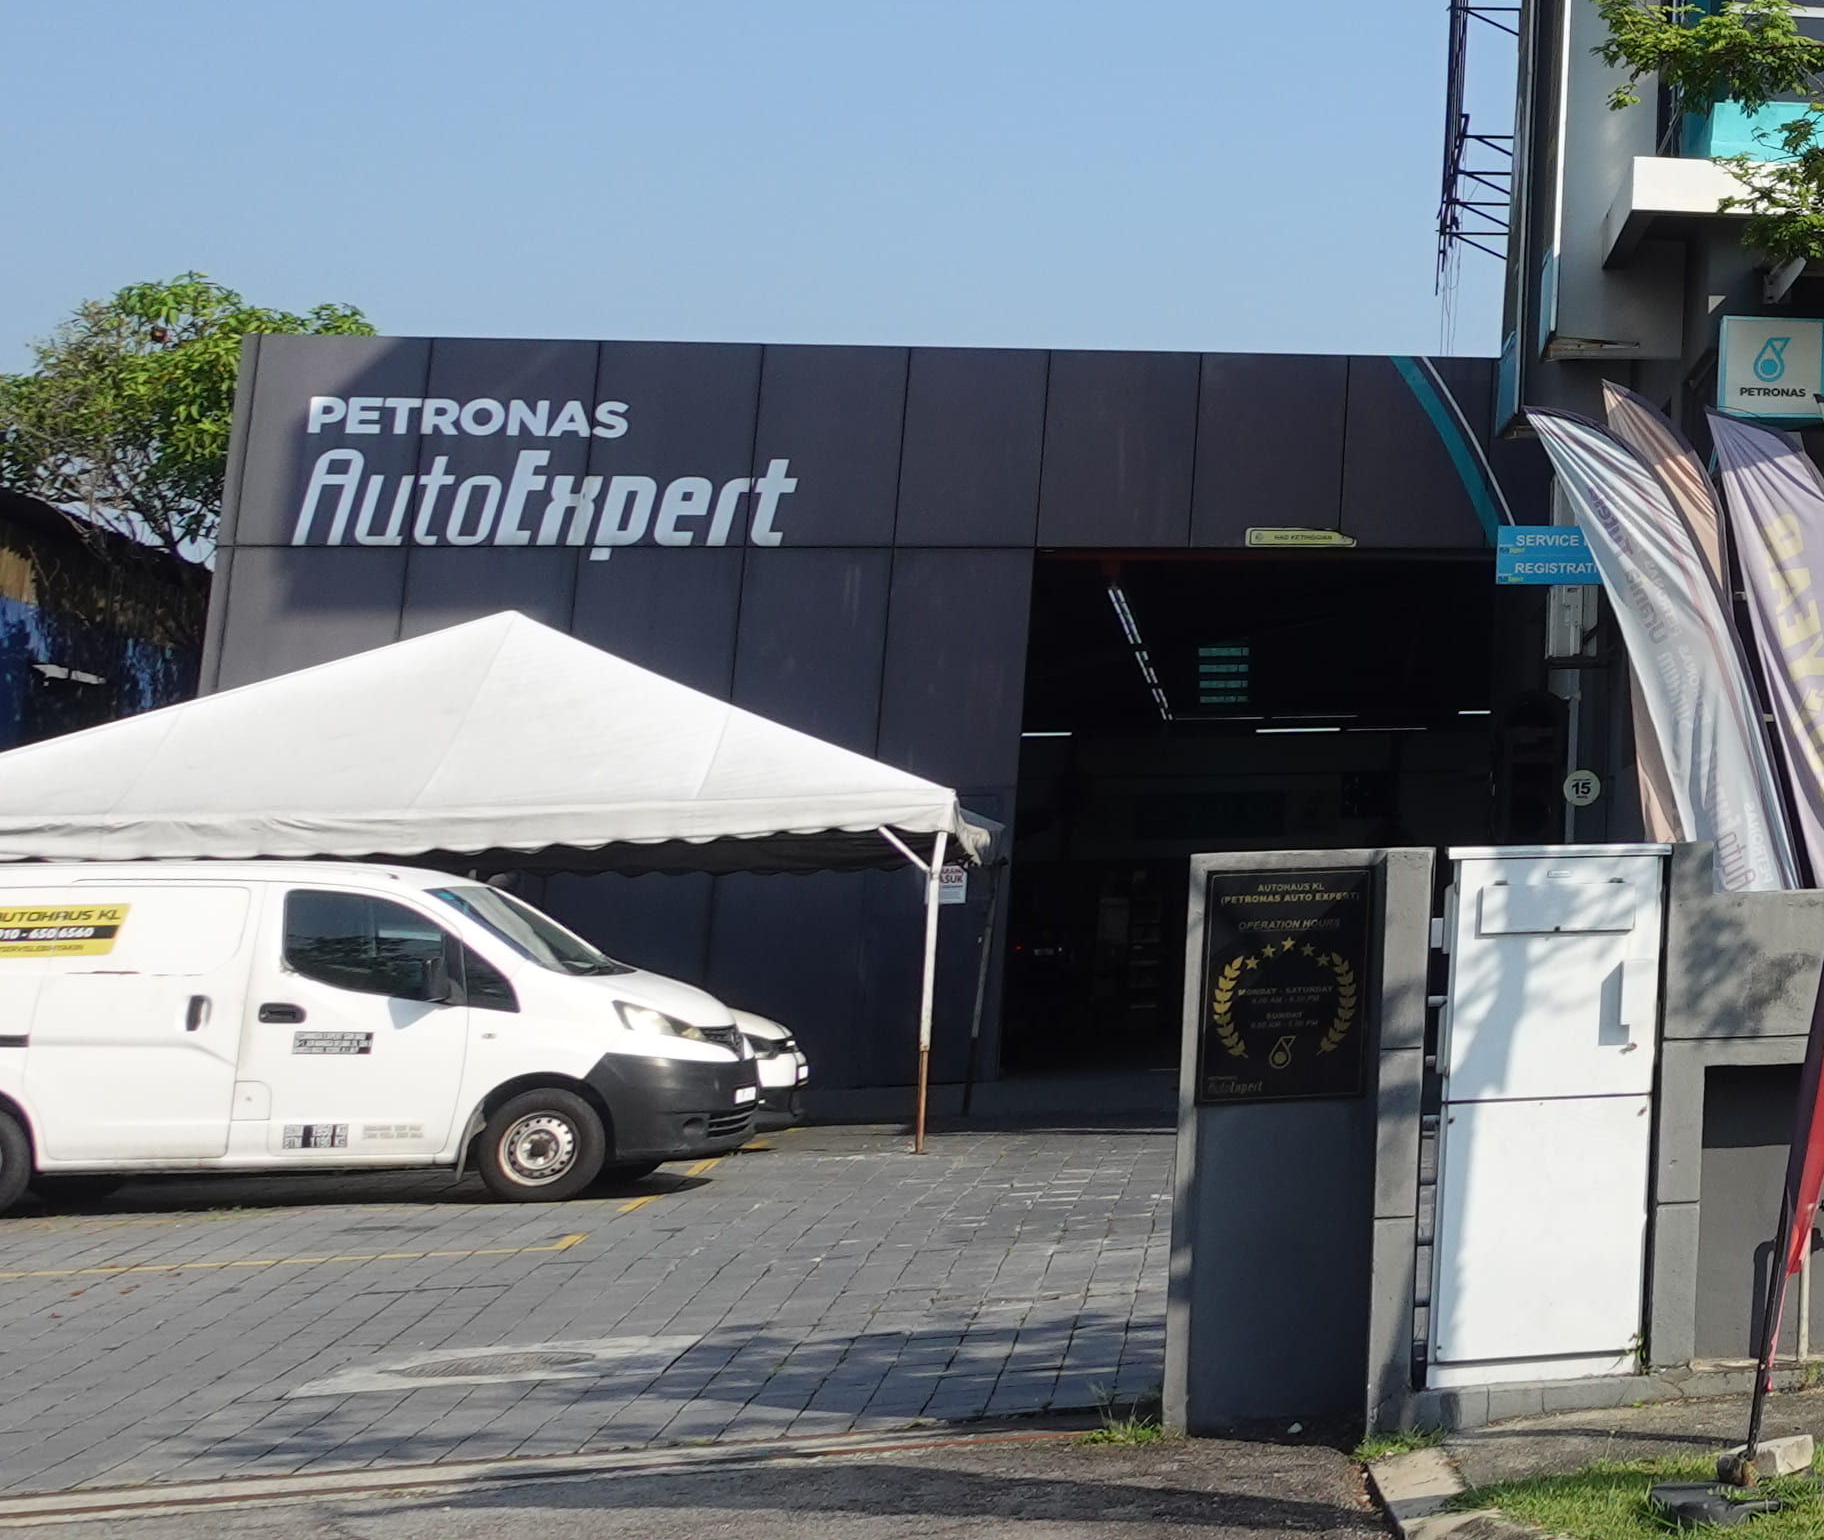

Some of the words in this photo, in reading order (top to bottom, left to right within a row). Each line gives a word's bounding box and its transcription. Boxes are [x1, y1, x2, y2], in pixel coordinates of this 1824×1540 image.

[1739, 386, 1807, 398] PETRONAS
[307, 396, 629, 439] PETRONAS
[292, 448, 800, 562] AutoExpert
[1515, 534, 1580, 547] SERVICE
[1571, 781, 1592, 795] 15
[1257, 883, 1310, 892] AUTOHAUS
[1311, 882, 1325, 891] KL
[1284, 893, 1313, 902] AUTO
[97, 909, 122, 921] KL
[1238, 919, 1300, 931] OPERATION
[1303, 918, 1341, 929] HOURS
